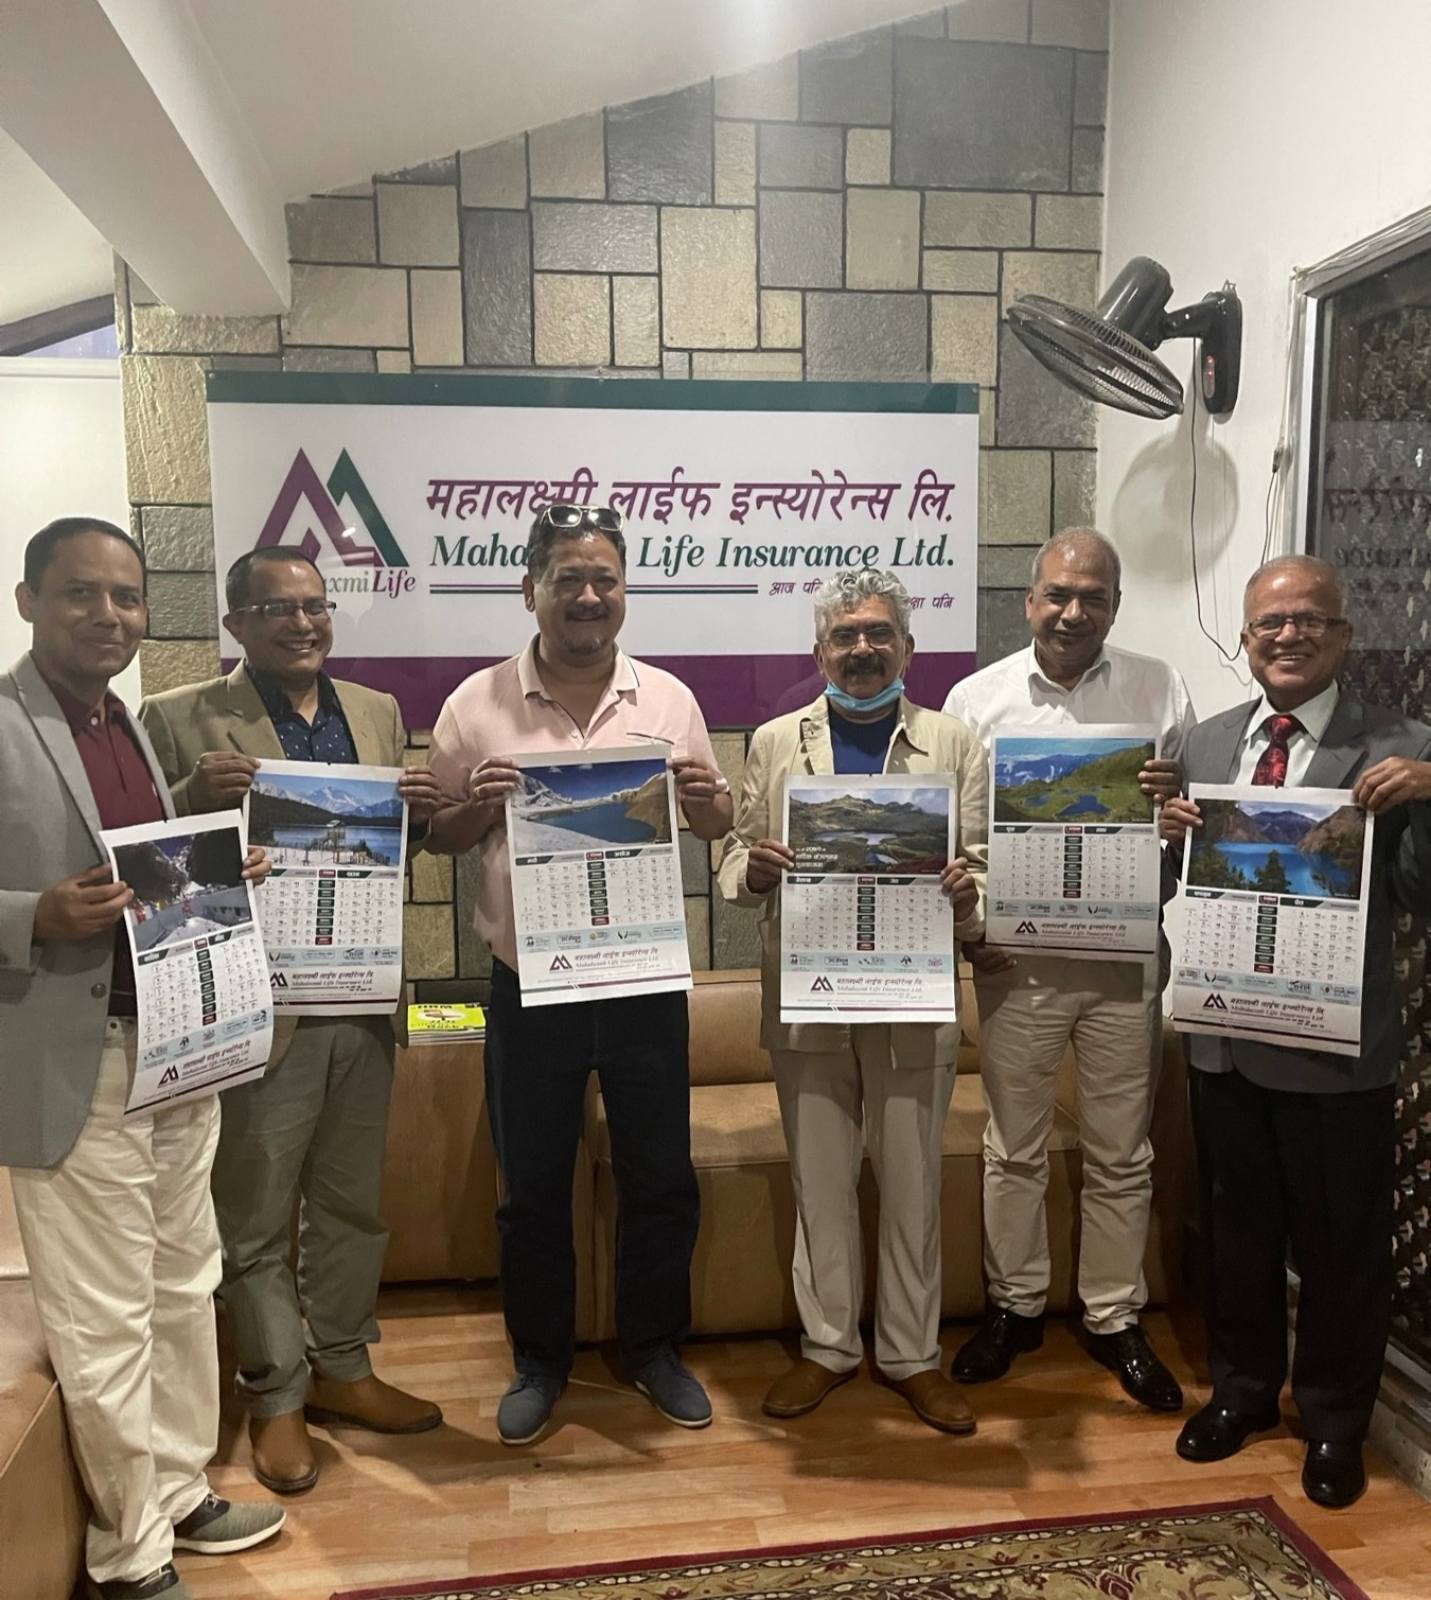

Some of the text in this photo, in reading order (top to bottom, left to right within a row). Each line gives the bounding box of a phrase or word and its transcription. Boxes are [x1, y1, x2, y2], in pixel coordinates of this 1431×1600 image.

[636, 534, 705, 577] Life
[715, 536, 880, 568] Insurance
[889, 534, 955, 567] Ltd.
